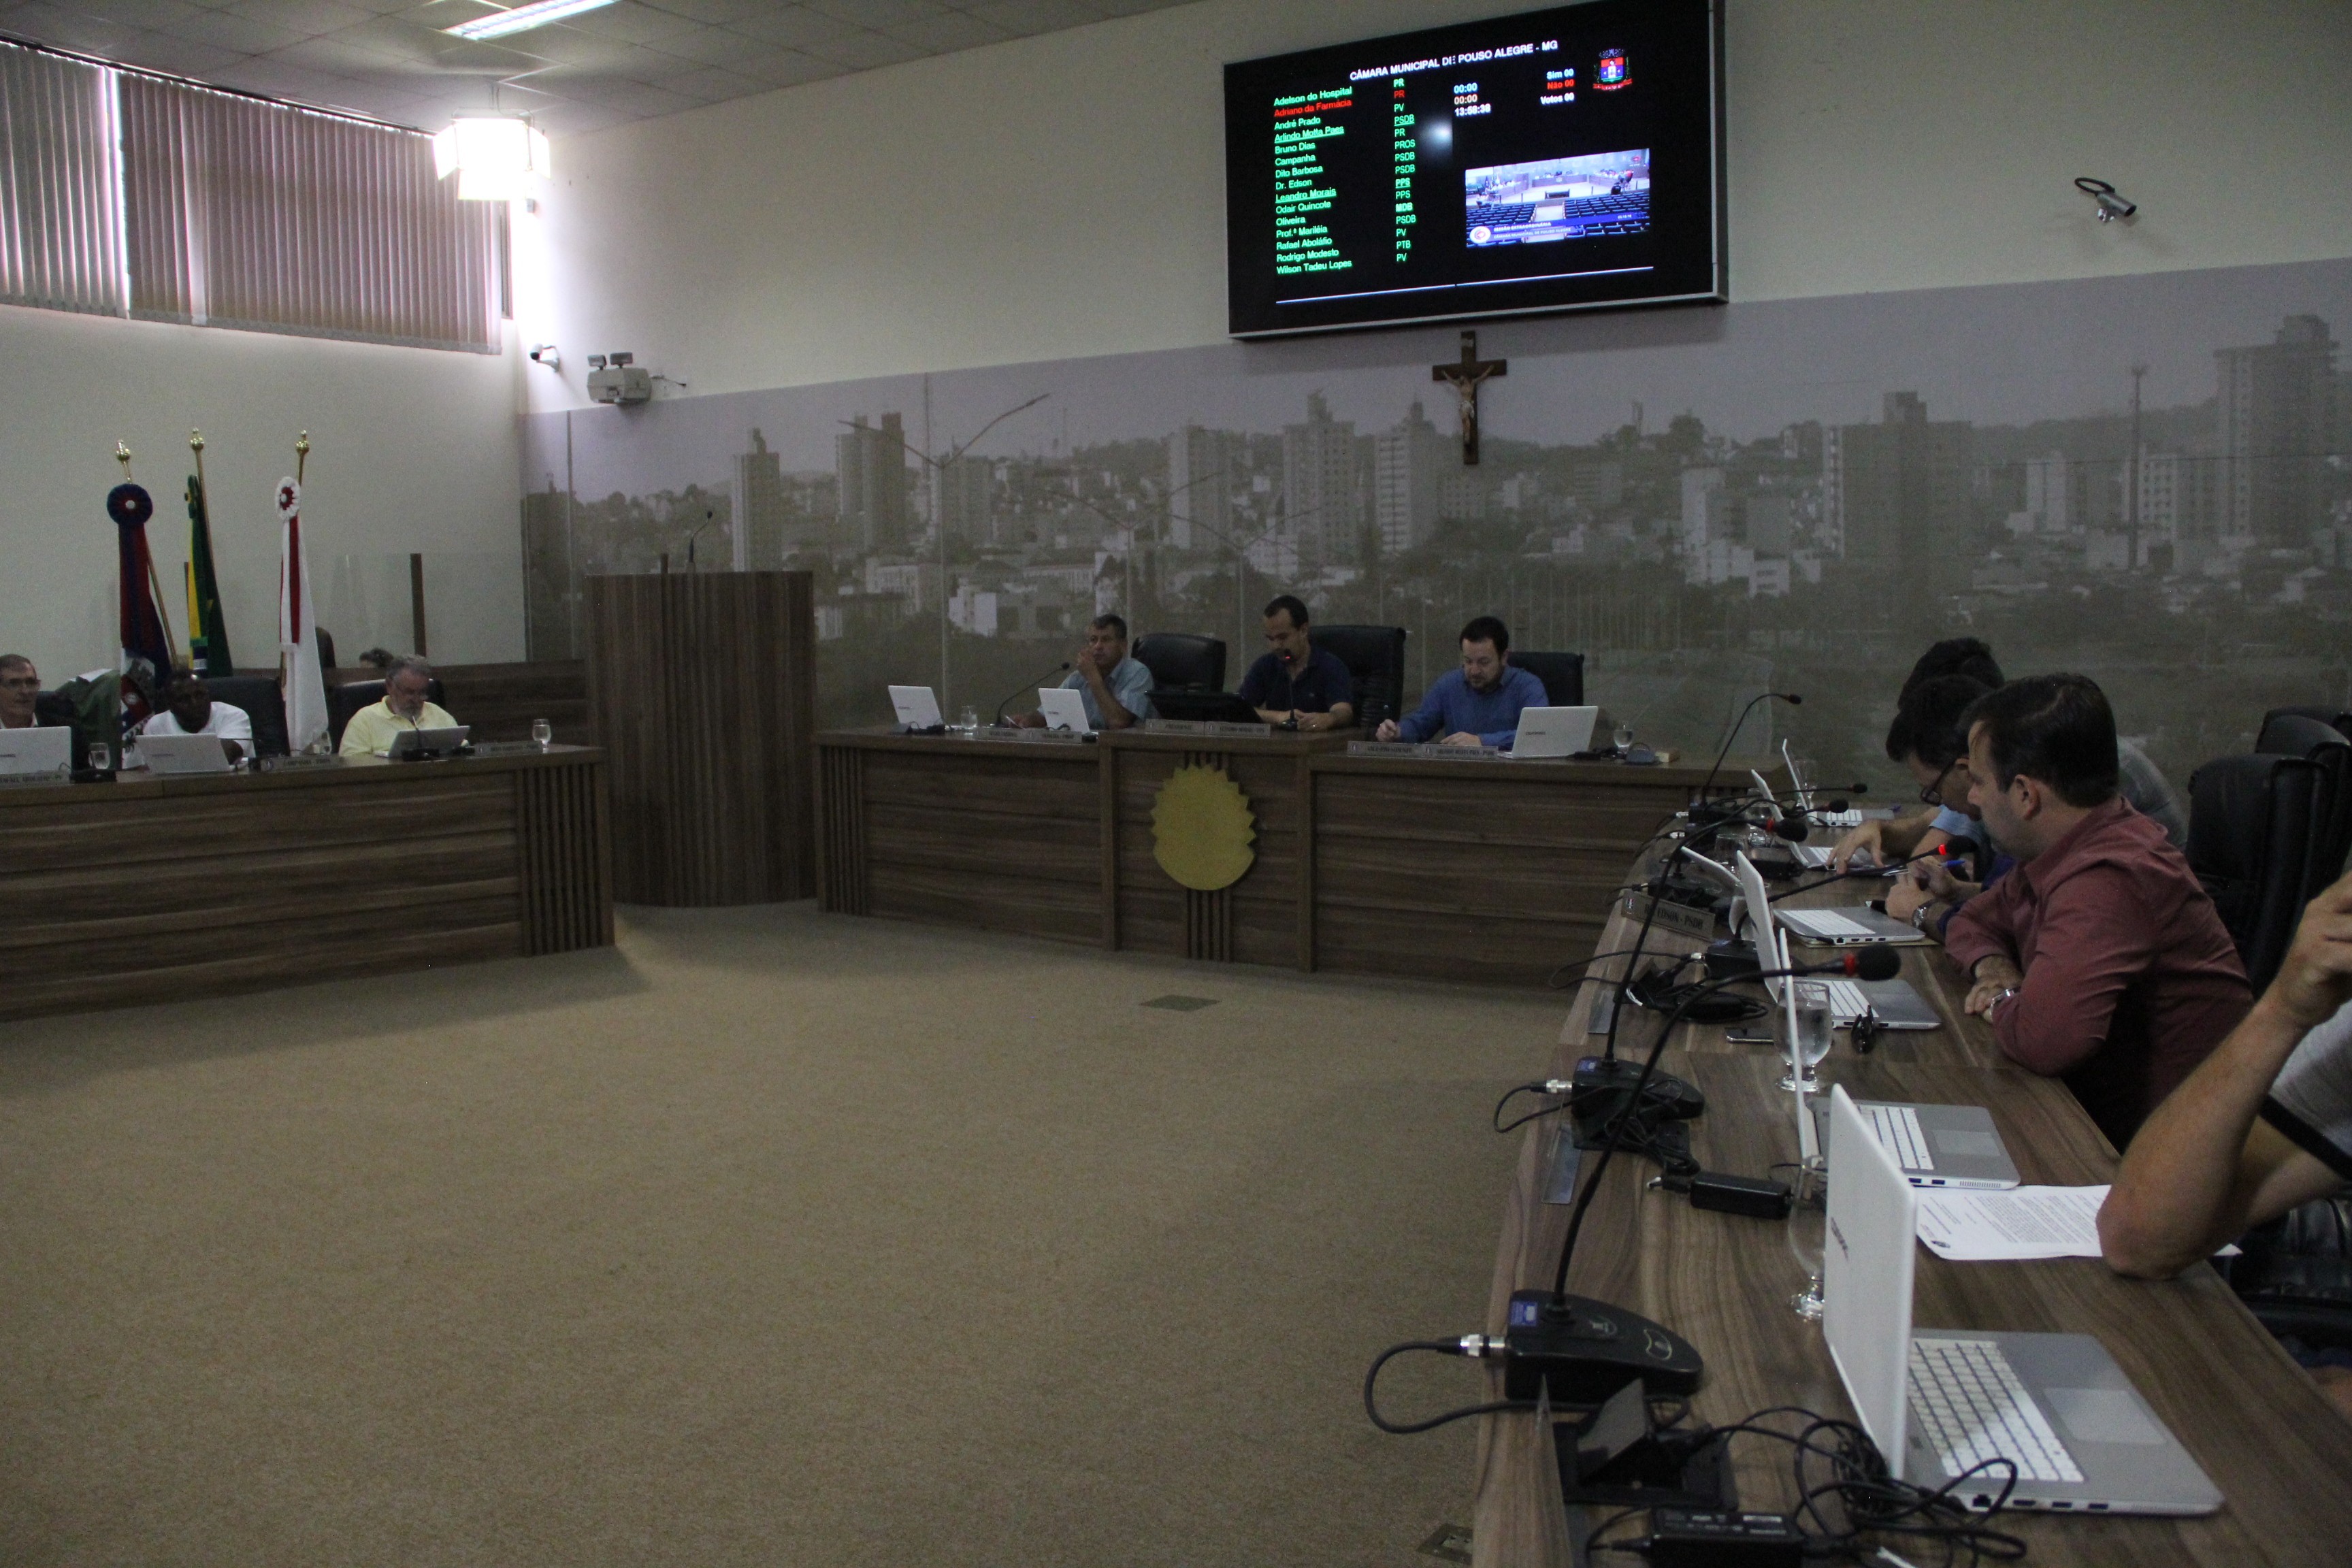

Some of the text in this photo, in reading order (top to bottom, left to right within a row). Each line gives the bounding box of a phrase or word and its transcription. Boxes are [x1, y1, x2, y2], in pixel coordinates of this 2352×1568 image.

[1350, 66, 1388, 81] CÂMARA
[1390, 59, 1440, 74] MUNICIPAL
[1458, 50, 1492, 63] POUSO
[1494, 44, 1533, 58] ALEGRE
[1541, 39, 1558, 51] MG
[1546, 68, 1574, 80] Sim 00
[1394, 78, 1404, 87] PR
[1454, 82, 1477, 94] 00:00
[1547, 79, 1575, 90] Não 00
[1274, 86, 1352, 106] Adelson do Hospital
[1394, 90, 1405, 98] PR
[1454, 94, 1477, 105] 00:00
[1540, 93, 1575, 105] Votos 00
[1274, 107, 1303, 117] Adriano
[1305, 103, 1315, 112] da
[1394, 103, 1404, 112] PV
[1274, 116, 1321, 130] André Prado
[1394, 114, 1414, 125] PSDB
[1275, 125, 1344, 142] Arlindo Motta Paes
[1394, 128, 1405, 137] PR
[1275, 142, 1316, 154] Bruno Dias
[1394, 140, 1415, 149] PROS
[1275, 154, 1316, 166] Campanha
[1395, 152, 1415, 161] PSDB
[1275, 165, 1323, 178] Dito Barbosa
[1395, 164, 1415, 174] PSDB
[1275, 179, 1312, 191] Dr. Edson
[1396, 178, 1411, 187] PPS
[1275, 187, 1337, 202] Leandro Morais
[1396, 190, 1411, 199] PPS
[1276, 201, 1331, 214] Odair Quincote
[1396, 202, 1413, 212] MDB
[1276, 216, 1306, 226] Oliveira
[1396, 214, 1416, 224] PSDB
[1396, 229, 1406, 237] PV
[1277, 240, 1300, 250] Rafael
[1396, 240, 1411, 249] PTB
[1277, 248, 1339, 263] Rodrigo Modesto
[1396, 253, 1407, 261] PV
[1277, 260, 1352, 274] Wilson Tadeu Lopes
